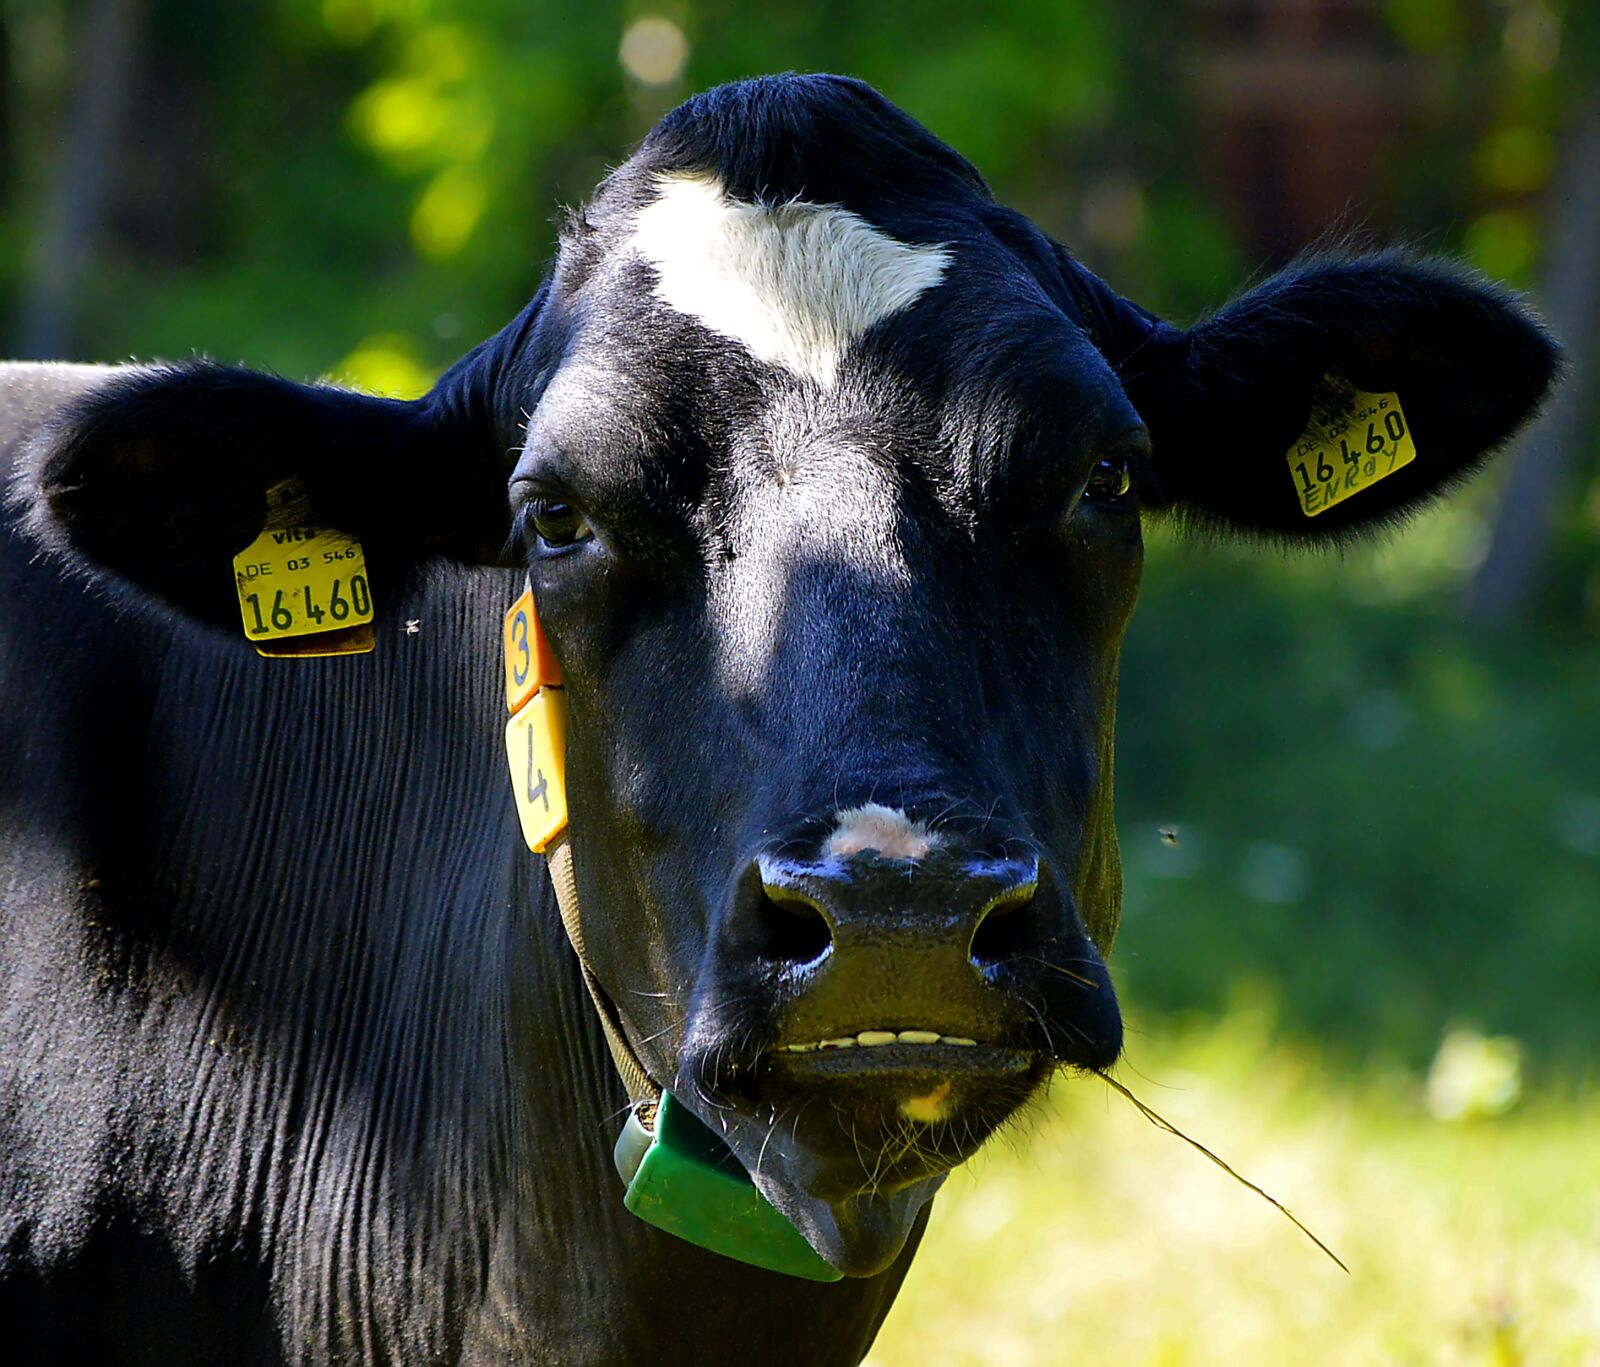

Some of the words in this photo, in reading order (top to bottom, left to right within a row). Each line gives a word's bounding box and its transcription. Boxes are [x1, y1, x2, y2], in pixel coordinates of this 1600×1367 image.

[1297, 442, 1320, 456] DE
[1358, 398, 1388, 421] 546
[246, 563, 272, 577] DE
[287, 557, 310, 571] 03
[323, 547, 355, 564] 546
[512, 611, 530, 686] 3
[528, 723, 549, 812] 4
